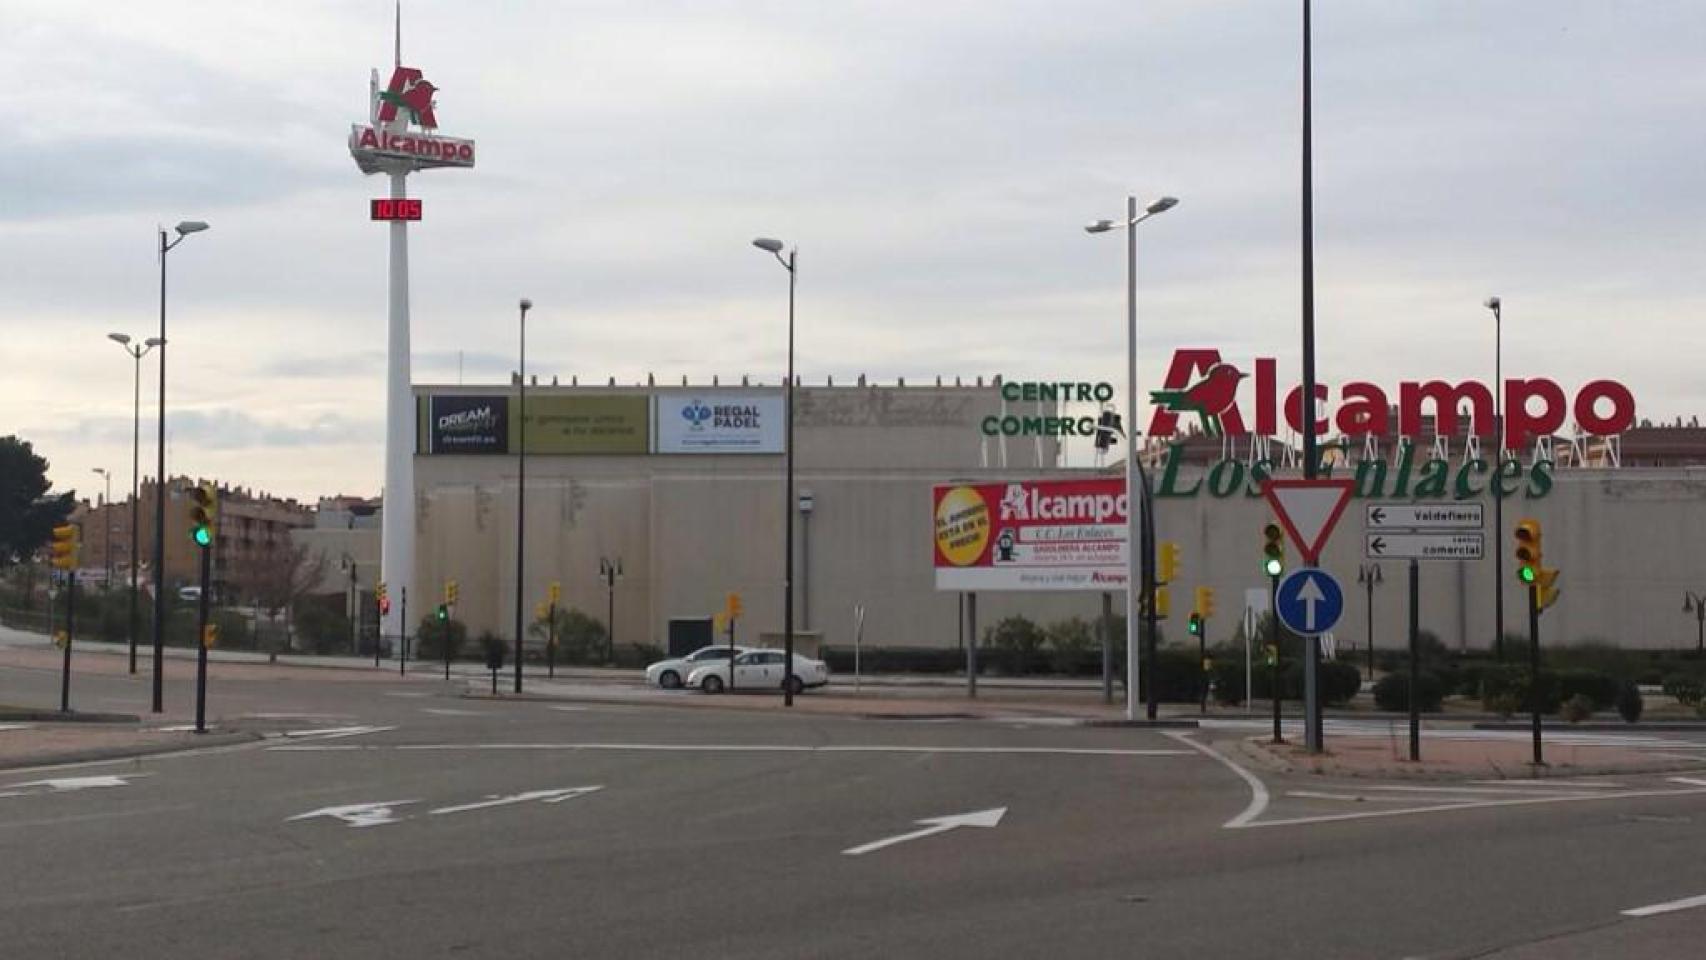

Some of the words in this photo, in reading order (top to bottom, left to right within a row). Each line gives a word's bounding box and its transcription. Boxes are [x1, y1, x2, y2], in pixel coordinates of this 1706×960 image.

[359, 128, 472, 160] Alcampo
[1002, 382, 1113, 402] CENTRO
[1148, 349, 1636, 449] Alcampo
[439, 405, 491, 430] DREAM
[714, 404, 760, 417] REGAL
[714, 416, 760, 429] PADEL
[981, 414, 1141, 437] COMERC
[1155, 442, 1273, 498] Los
[1000, 484, 1128, 522] Alcampo
[1414, 509, 1480, 521] Valdefierro
[1422, 545, 1480, 555] comercial
